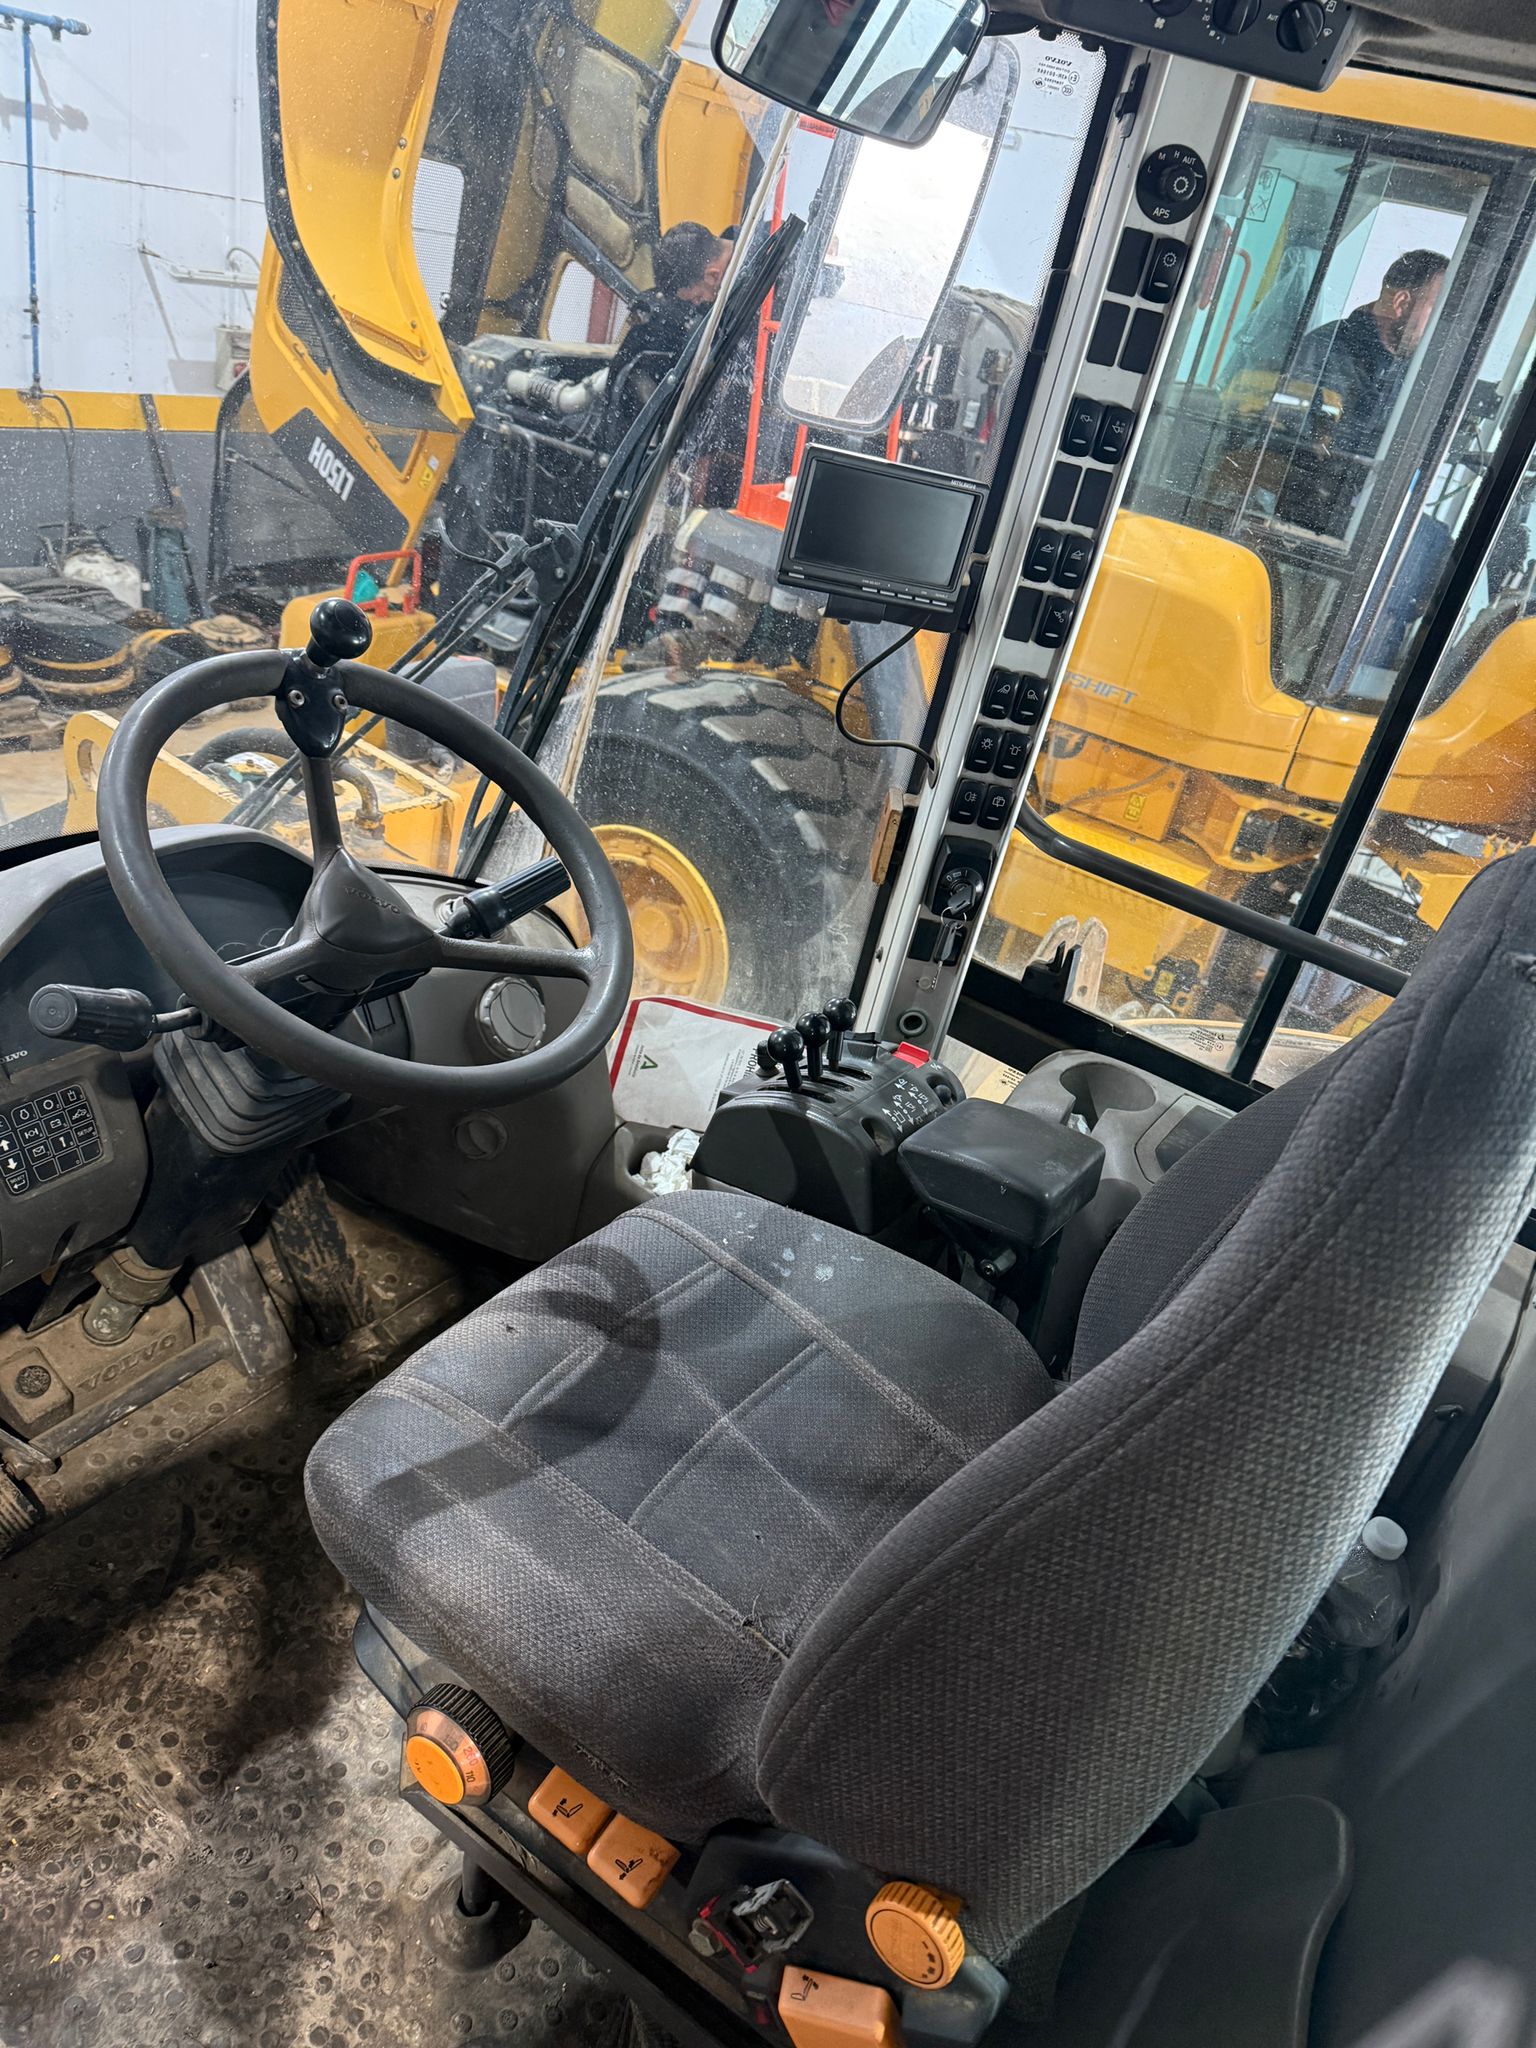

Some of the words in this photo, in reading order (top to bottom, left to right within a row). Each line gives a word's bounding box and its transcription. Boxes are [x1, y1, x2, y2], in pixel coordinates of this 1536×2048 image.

[1158, 152, 1166, 160] M
[1173, 150, 1180, 158] H
[1182, 155, 1196, 165] AUT
[1152, 206, 1171, 218] APS
[308, 436, 355, 501] L150H
[344, 887, 400, 914] VOLVO
[0, 1050, 28, 1064] OLVO
[77, 1335, 176, 1391] VOLVO
